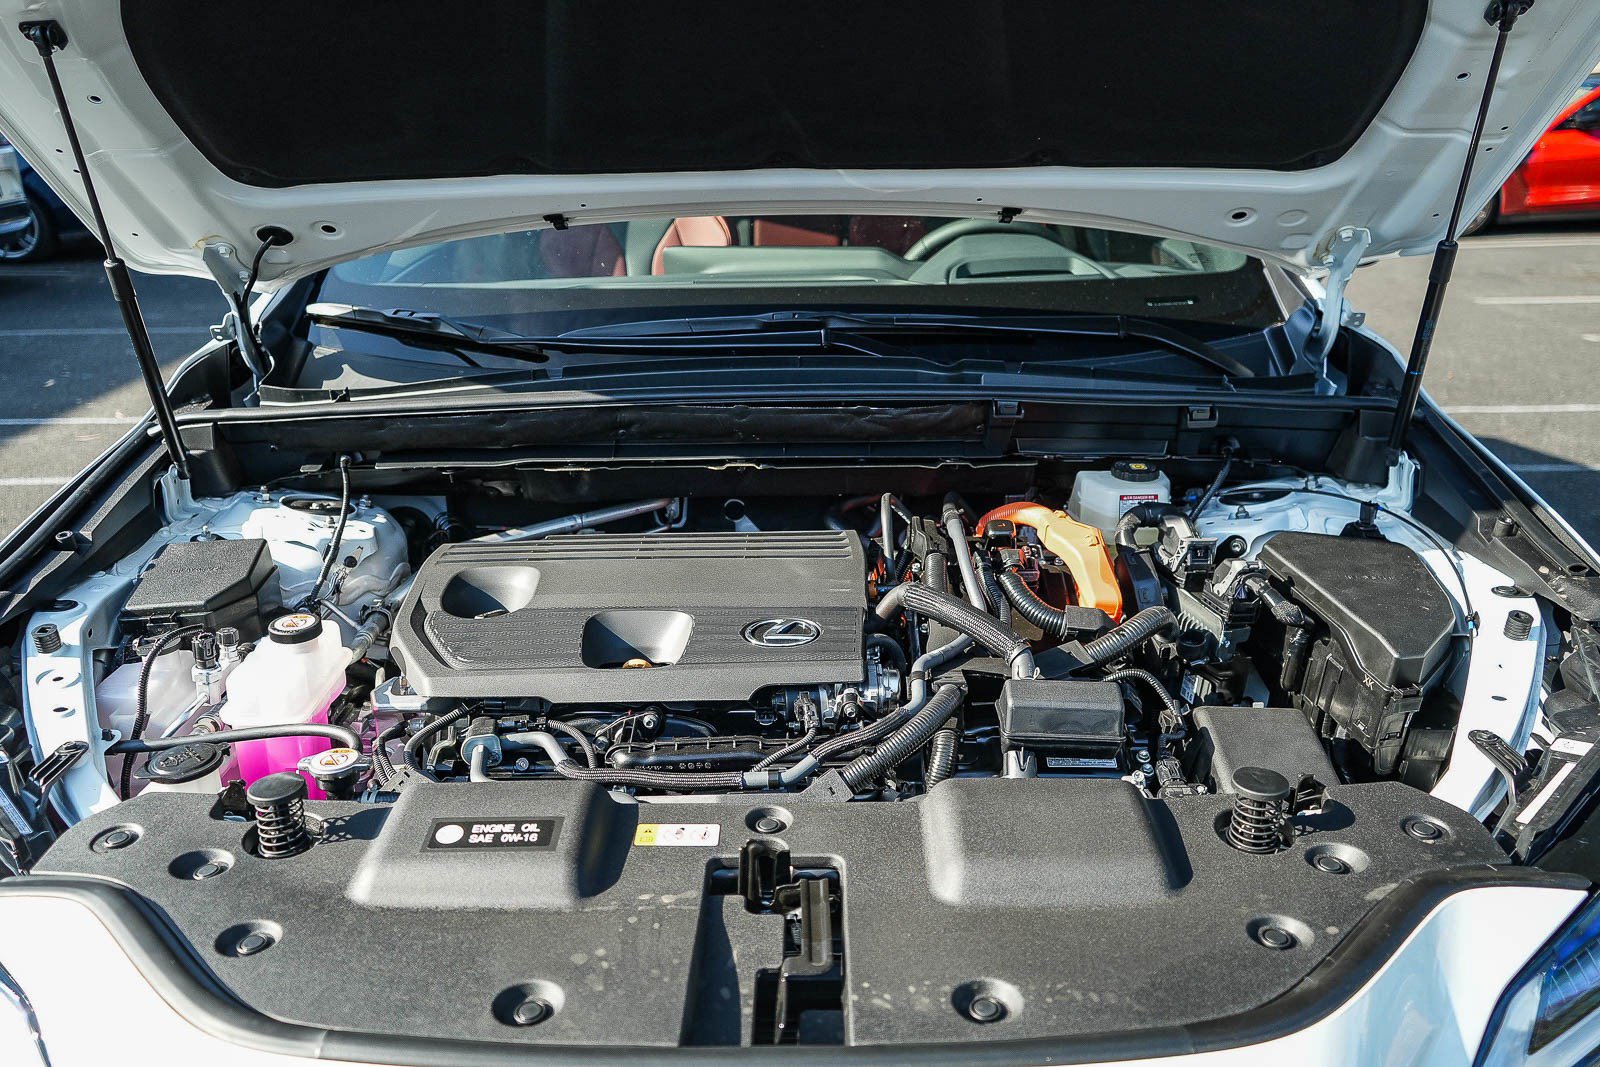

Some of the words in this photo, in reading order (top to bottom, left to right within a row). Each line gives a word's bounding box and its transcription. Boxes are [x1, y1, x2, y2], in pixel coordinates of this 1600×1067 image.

[1362, 674, 1375, 690] XK
[471, 823, 514, 833] ENGINE
[520, 823, 541, 832] OIL
[468, 833, 494, 843] SAE
[501, 833, 538, 842] 0W-16
